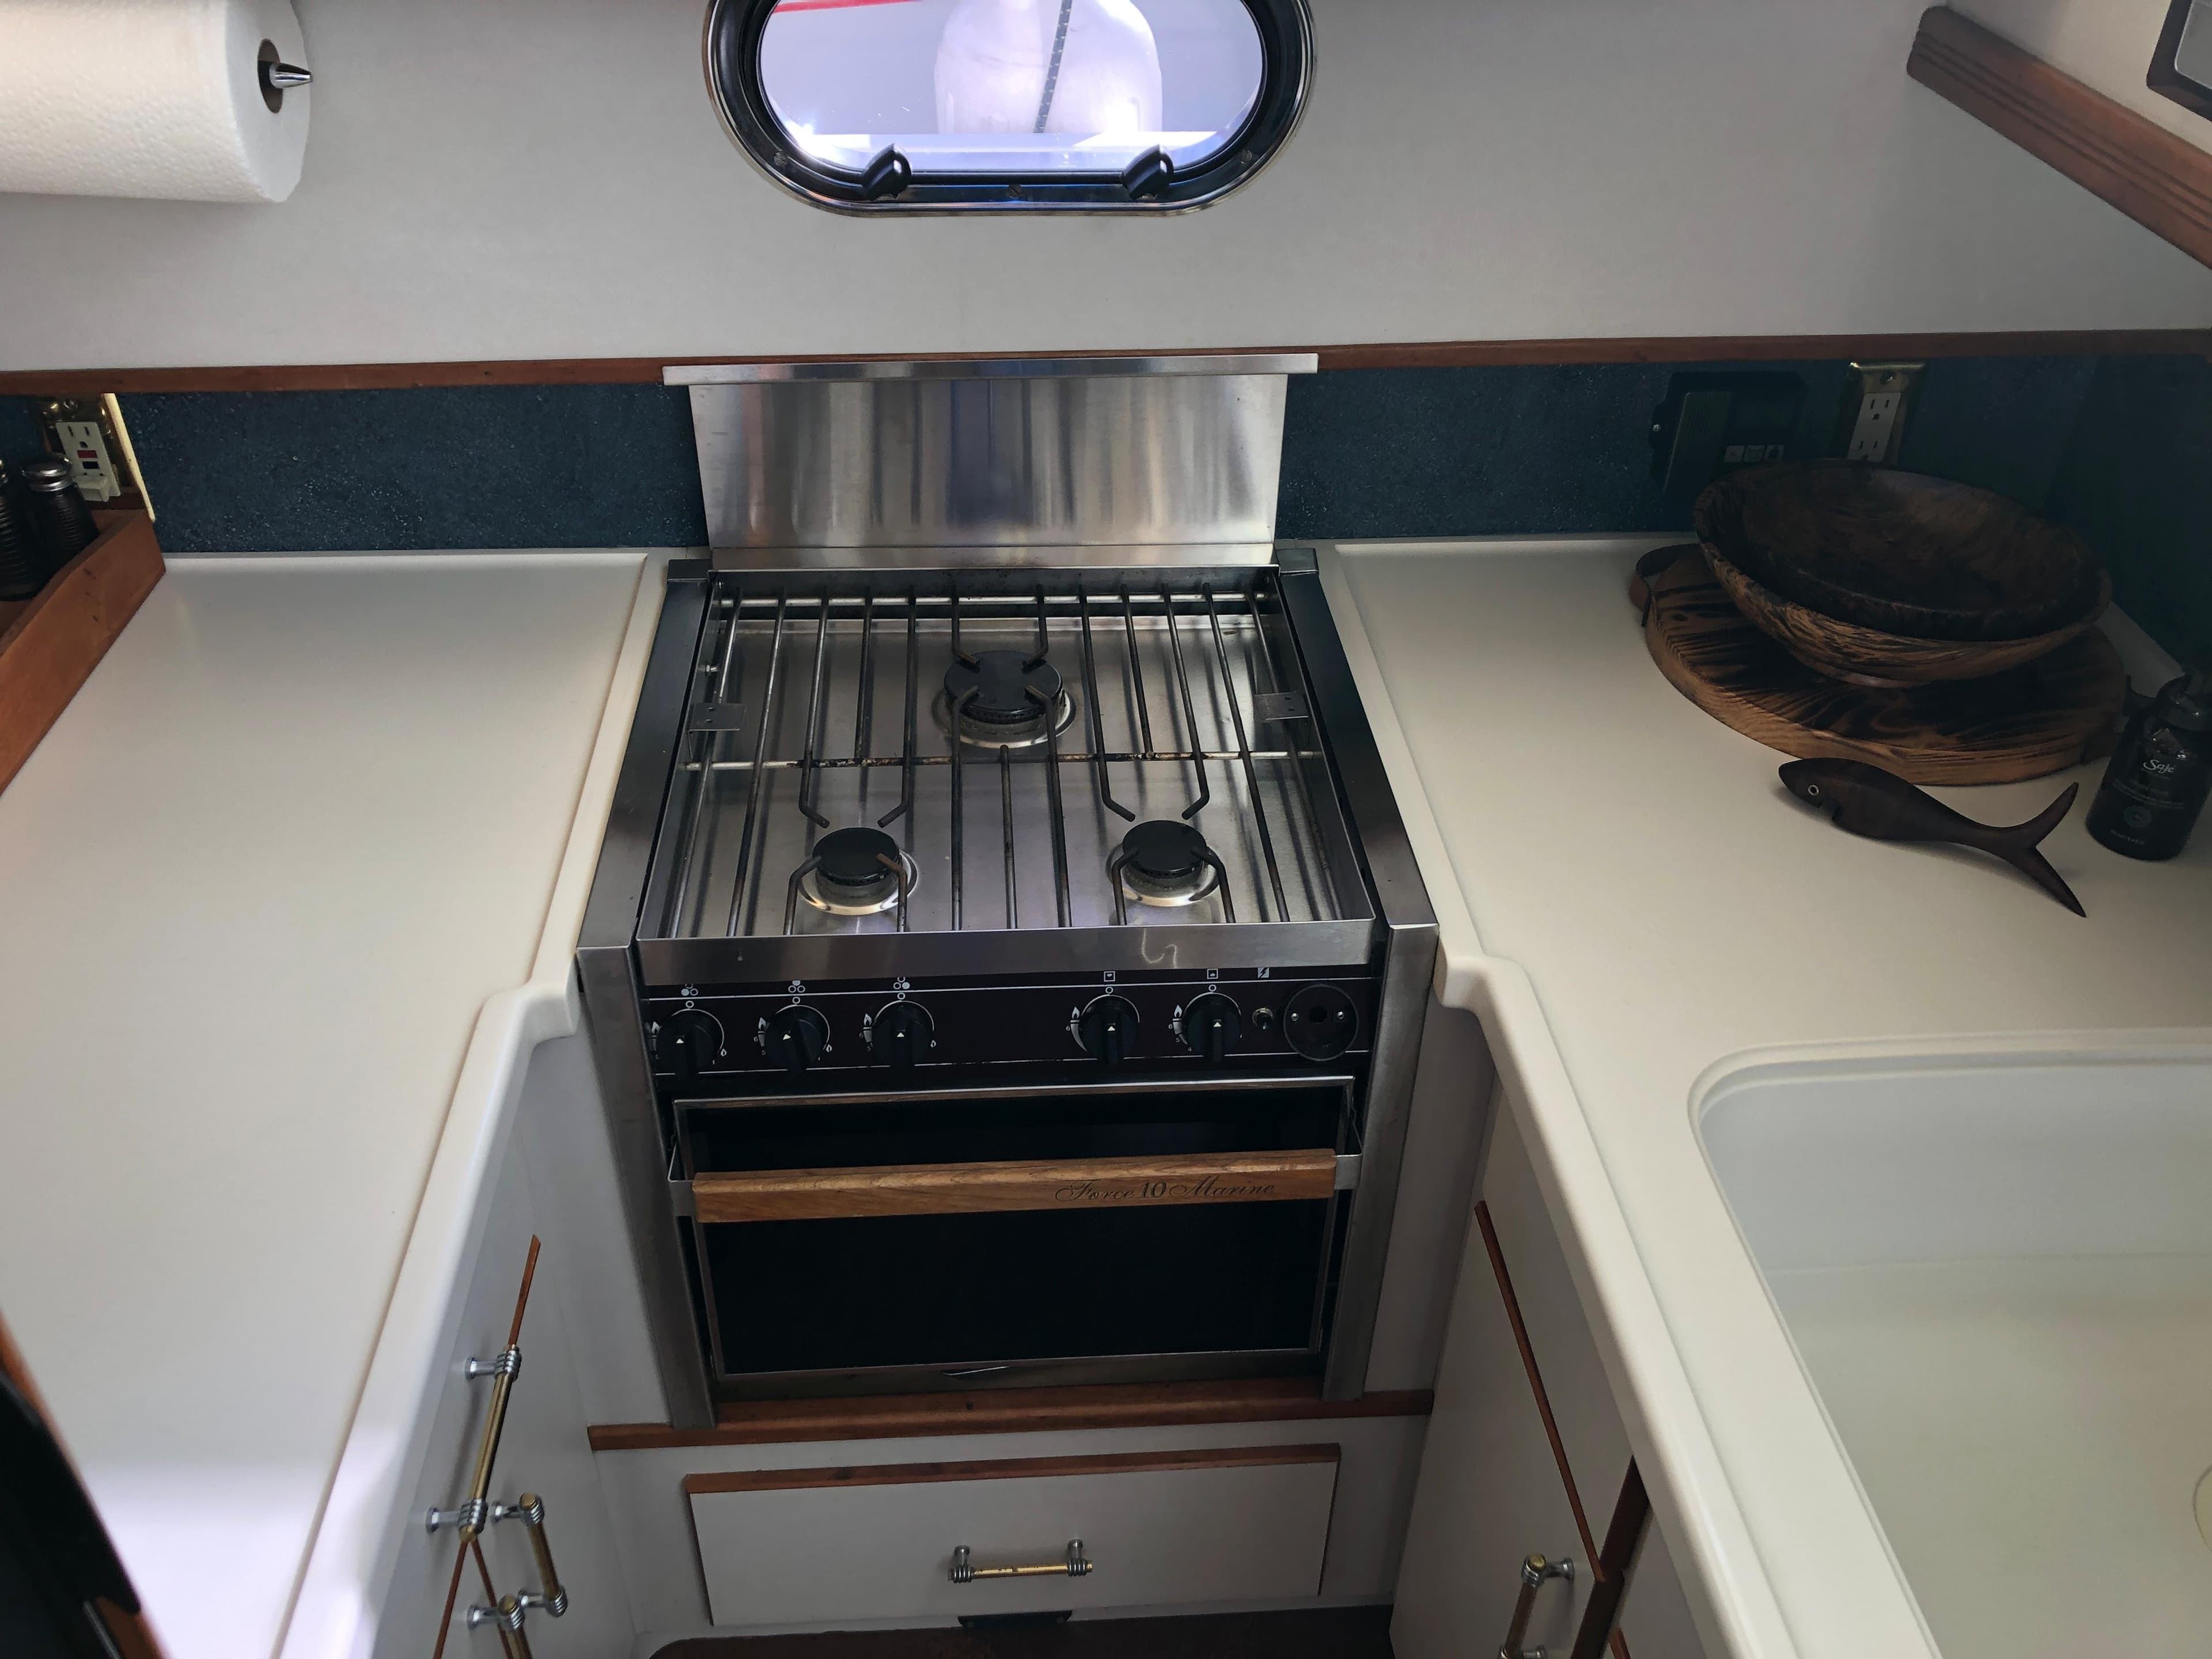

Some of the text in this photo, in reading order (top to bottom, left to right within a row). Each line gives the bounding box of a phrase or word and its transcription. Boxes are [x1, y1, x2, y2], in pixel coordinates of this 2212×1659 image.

[2143, 759, 2175, 774] Saje
[1055, 1175, 1275, 1202] Force 10 Marine
